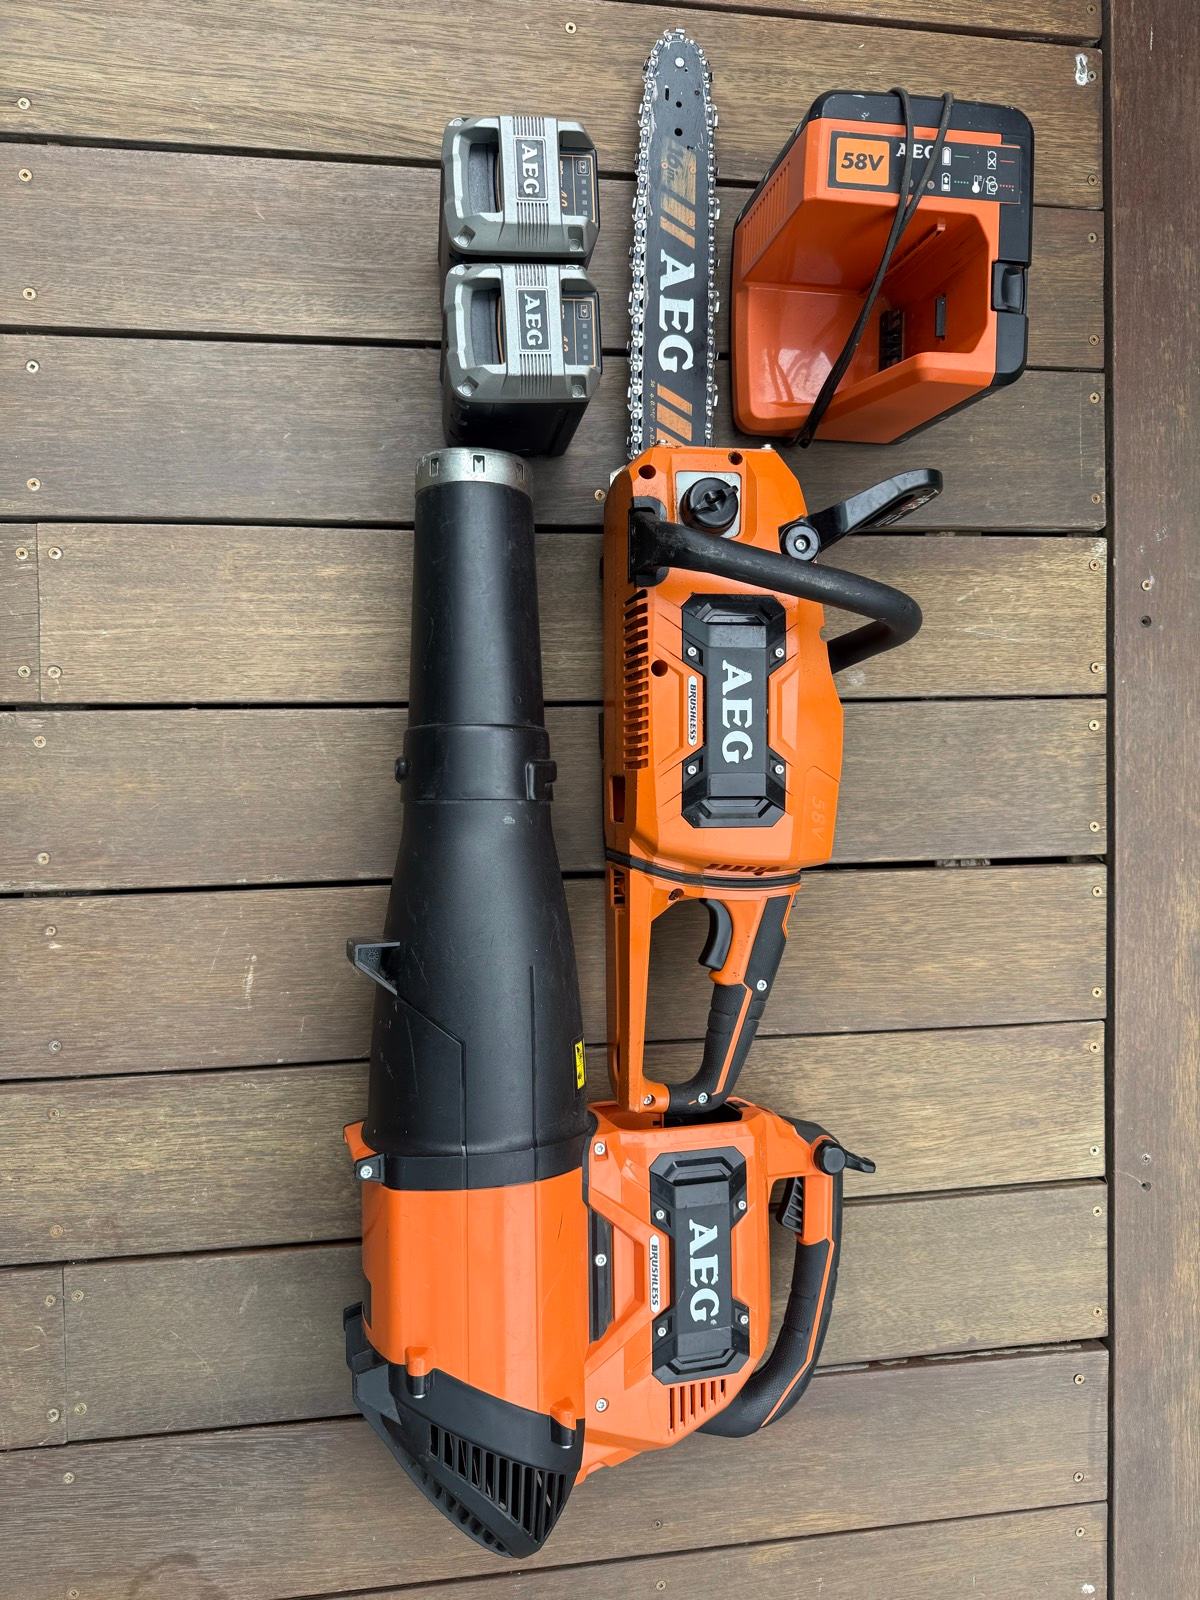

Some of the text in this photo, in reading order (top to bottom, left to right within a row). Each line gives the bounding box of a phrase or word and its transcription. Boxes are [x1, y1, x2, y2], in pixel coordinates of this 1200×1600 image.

[520, 144, 541, 196] AEG
[840, 151, 885, 172] 58V
[524, 293, 543, 347] AEG
[657, 248, 695, 374] AEG
[688, 683, 697, 741] BRUSHLESS
[721, 659, 754, 764] AEG
[650, 1243, 659, 1307] BRUSHLESS
[688, 1218, 720, 1323] AEG
